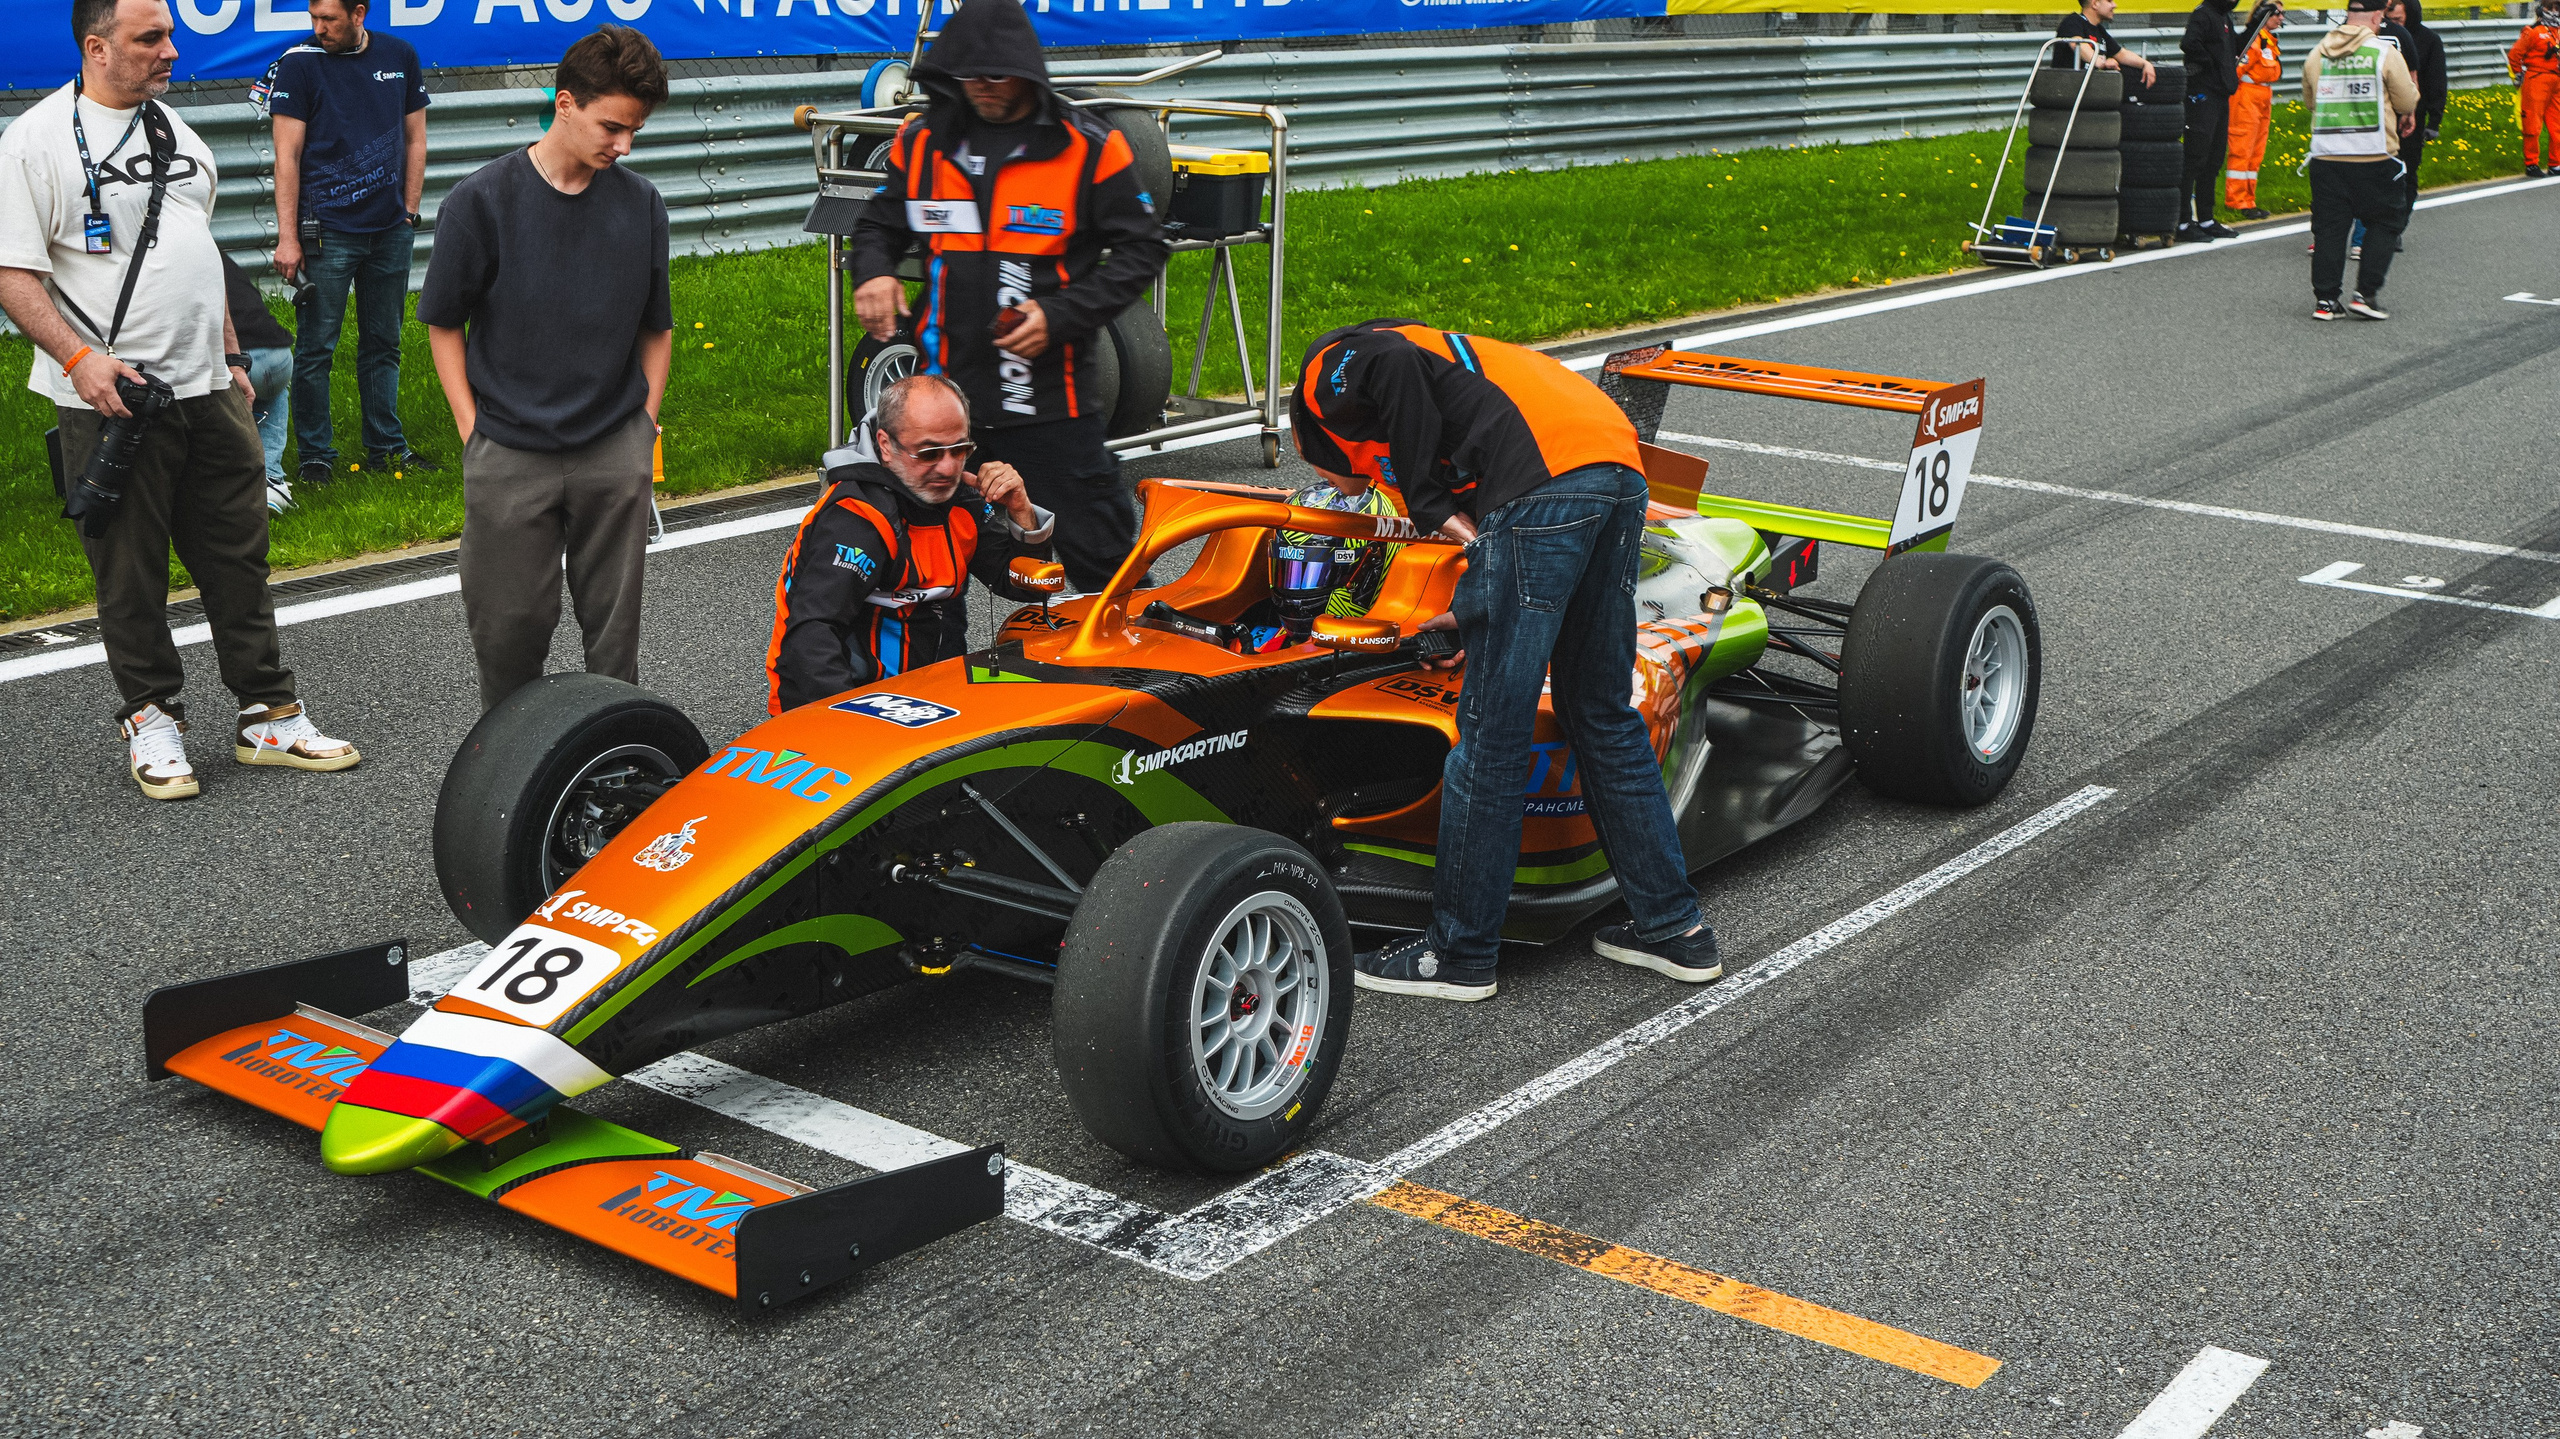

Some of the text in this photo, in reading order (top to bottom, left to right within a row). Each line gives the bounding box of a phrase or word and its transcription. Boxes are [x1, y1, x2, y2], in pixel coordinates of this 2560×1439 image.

[2320, 55, 2373, 70] РЕССА
[1915, 449, 1951, 522] 18
[835, 543, 876, 576] TMC
[1279, 546, 1305, 560] TMC
[1337, 552, 1354, 561] DSV
[1029, 576, 1062, 585] LANSOFT
[1010, 610, 1081, 628] DSV
[1311, 631, 1395, 645] SOFT LANSOFT
[1387, 679, 1460, 705] DSV
[1134, 729, 1248, 775] SMPKARTING
[703, 746, 852, 803] TMC
[1523, 800, 1585, 813] РАНСМЕ
[1283, 899, 1322, 946] OZ RACING
[477, 937, 584, 1005] 18
[1201, 1065, 1240, 1115] OZ RACING
[647, 1170, 756, 1237] TM
